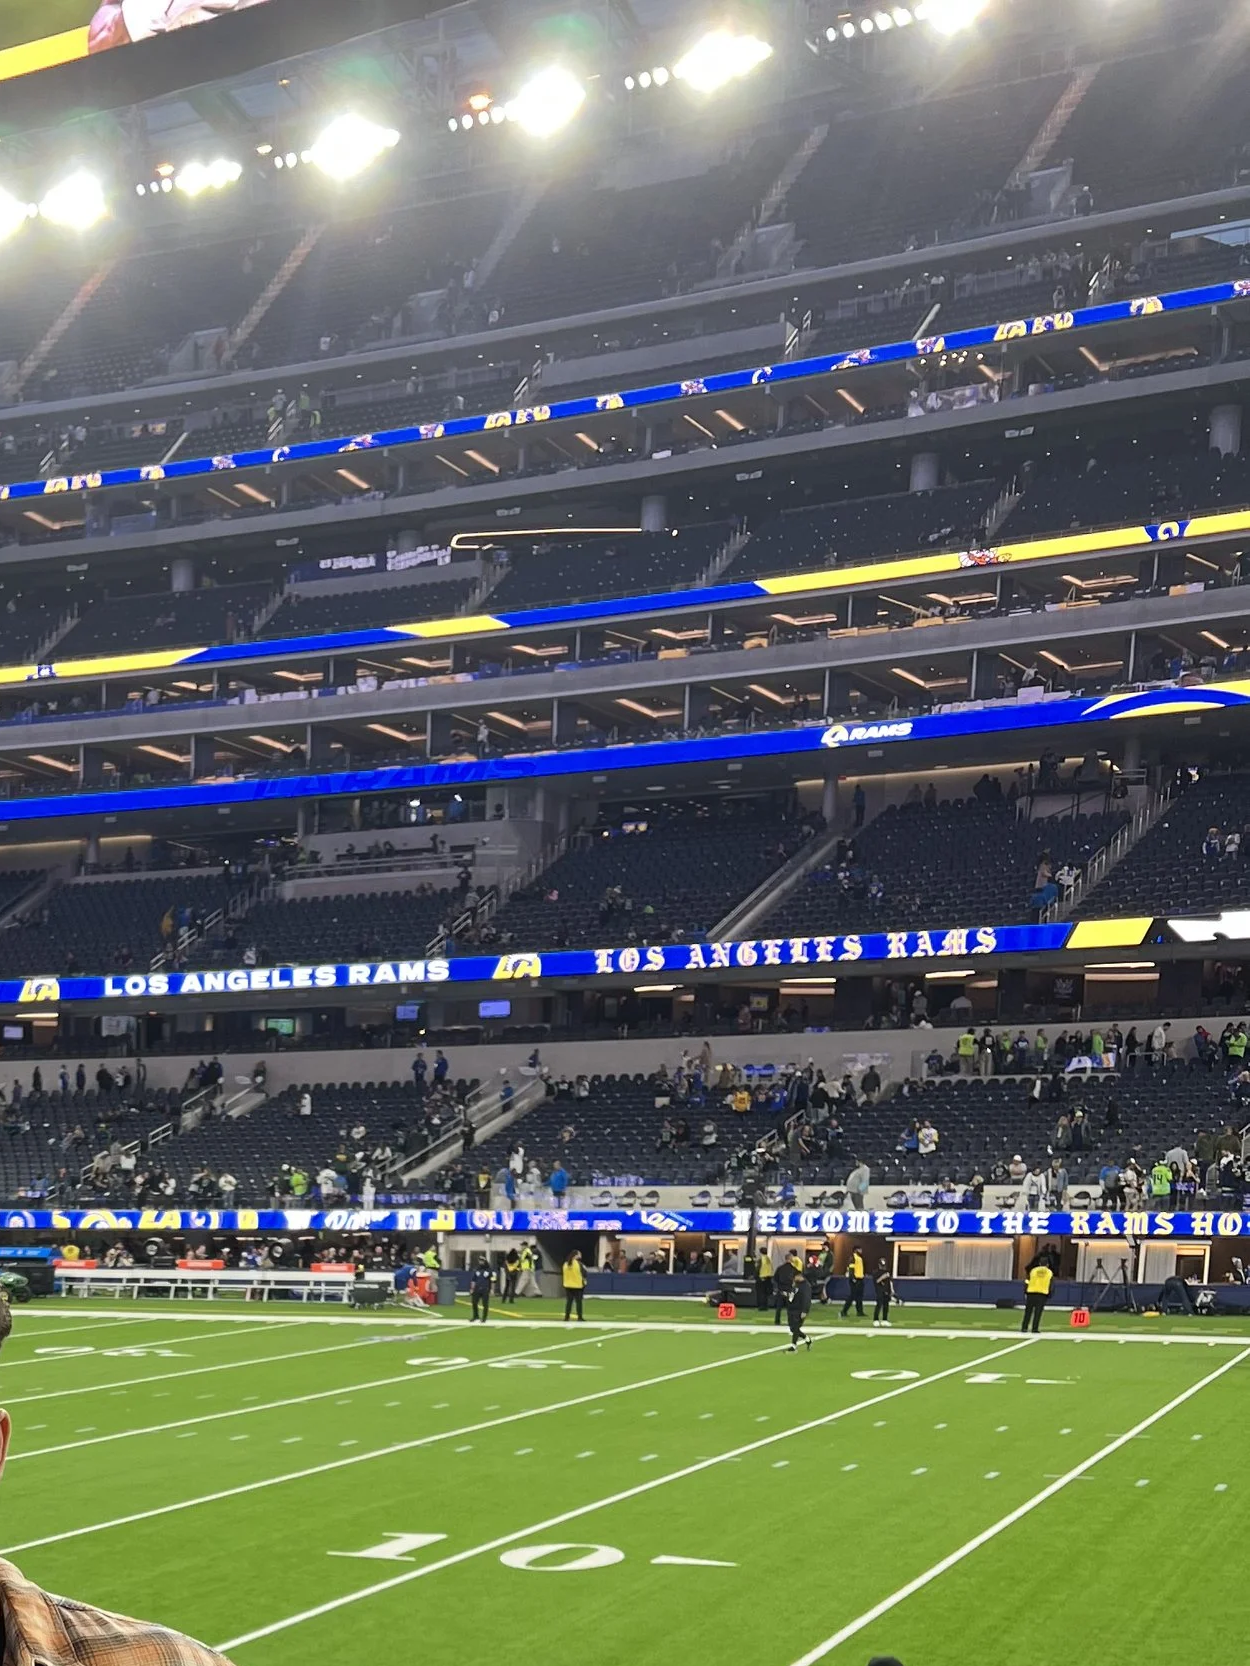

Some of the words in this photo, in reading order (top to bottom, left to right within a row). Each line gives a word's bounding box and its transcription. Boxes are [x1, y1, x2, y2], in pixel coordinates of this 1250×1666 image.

[849, 723, 913, 740] RAMS
[594, 945, 665, 974] LOS
[685, 934, 864, 970] ANGELES
[886, 926, 998, 960] RAMS
[104, 973, 169, 996] LOS
[180, 966, 337, 993] ANGELES
[349, 958, 449, 985] RAMS
[733, 1210, 894, 1233] WELCOME
[913, 1210, 960, 1234] TO
[976, 1211, 1050, 1235] THE
[1070, 1211, 1174, 1235] RAMS
[1191, 1211, 1250, 1236] HO
[719, 1305, 733, 1317] 20
[1074, 1312, 1087, 1324] 10
